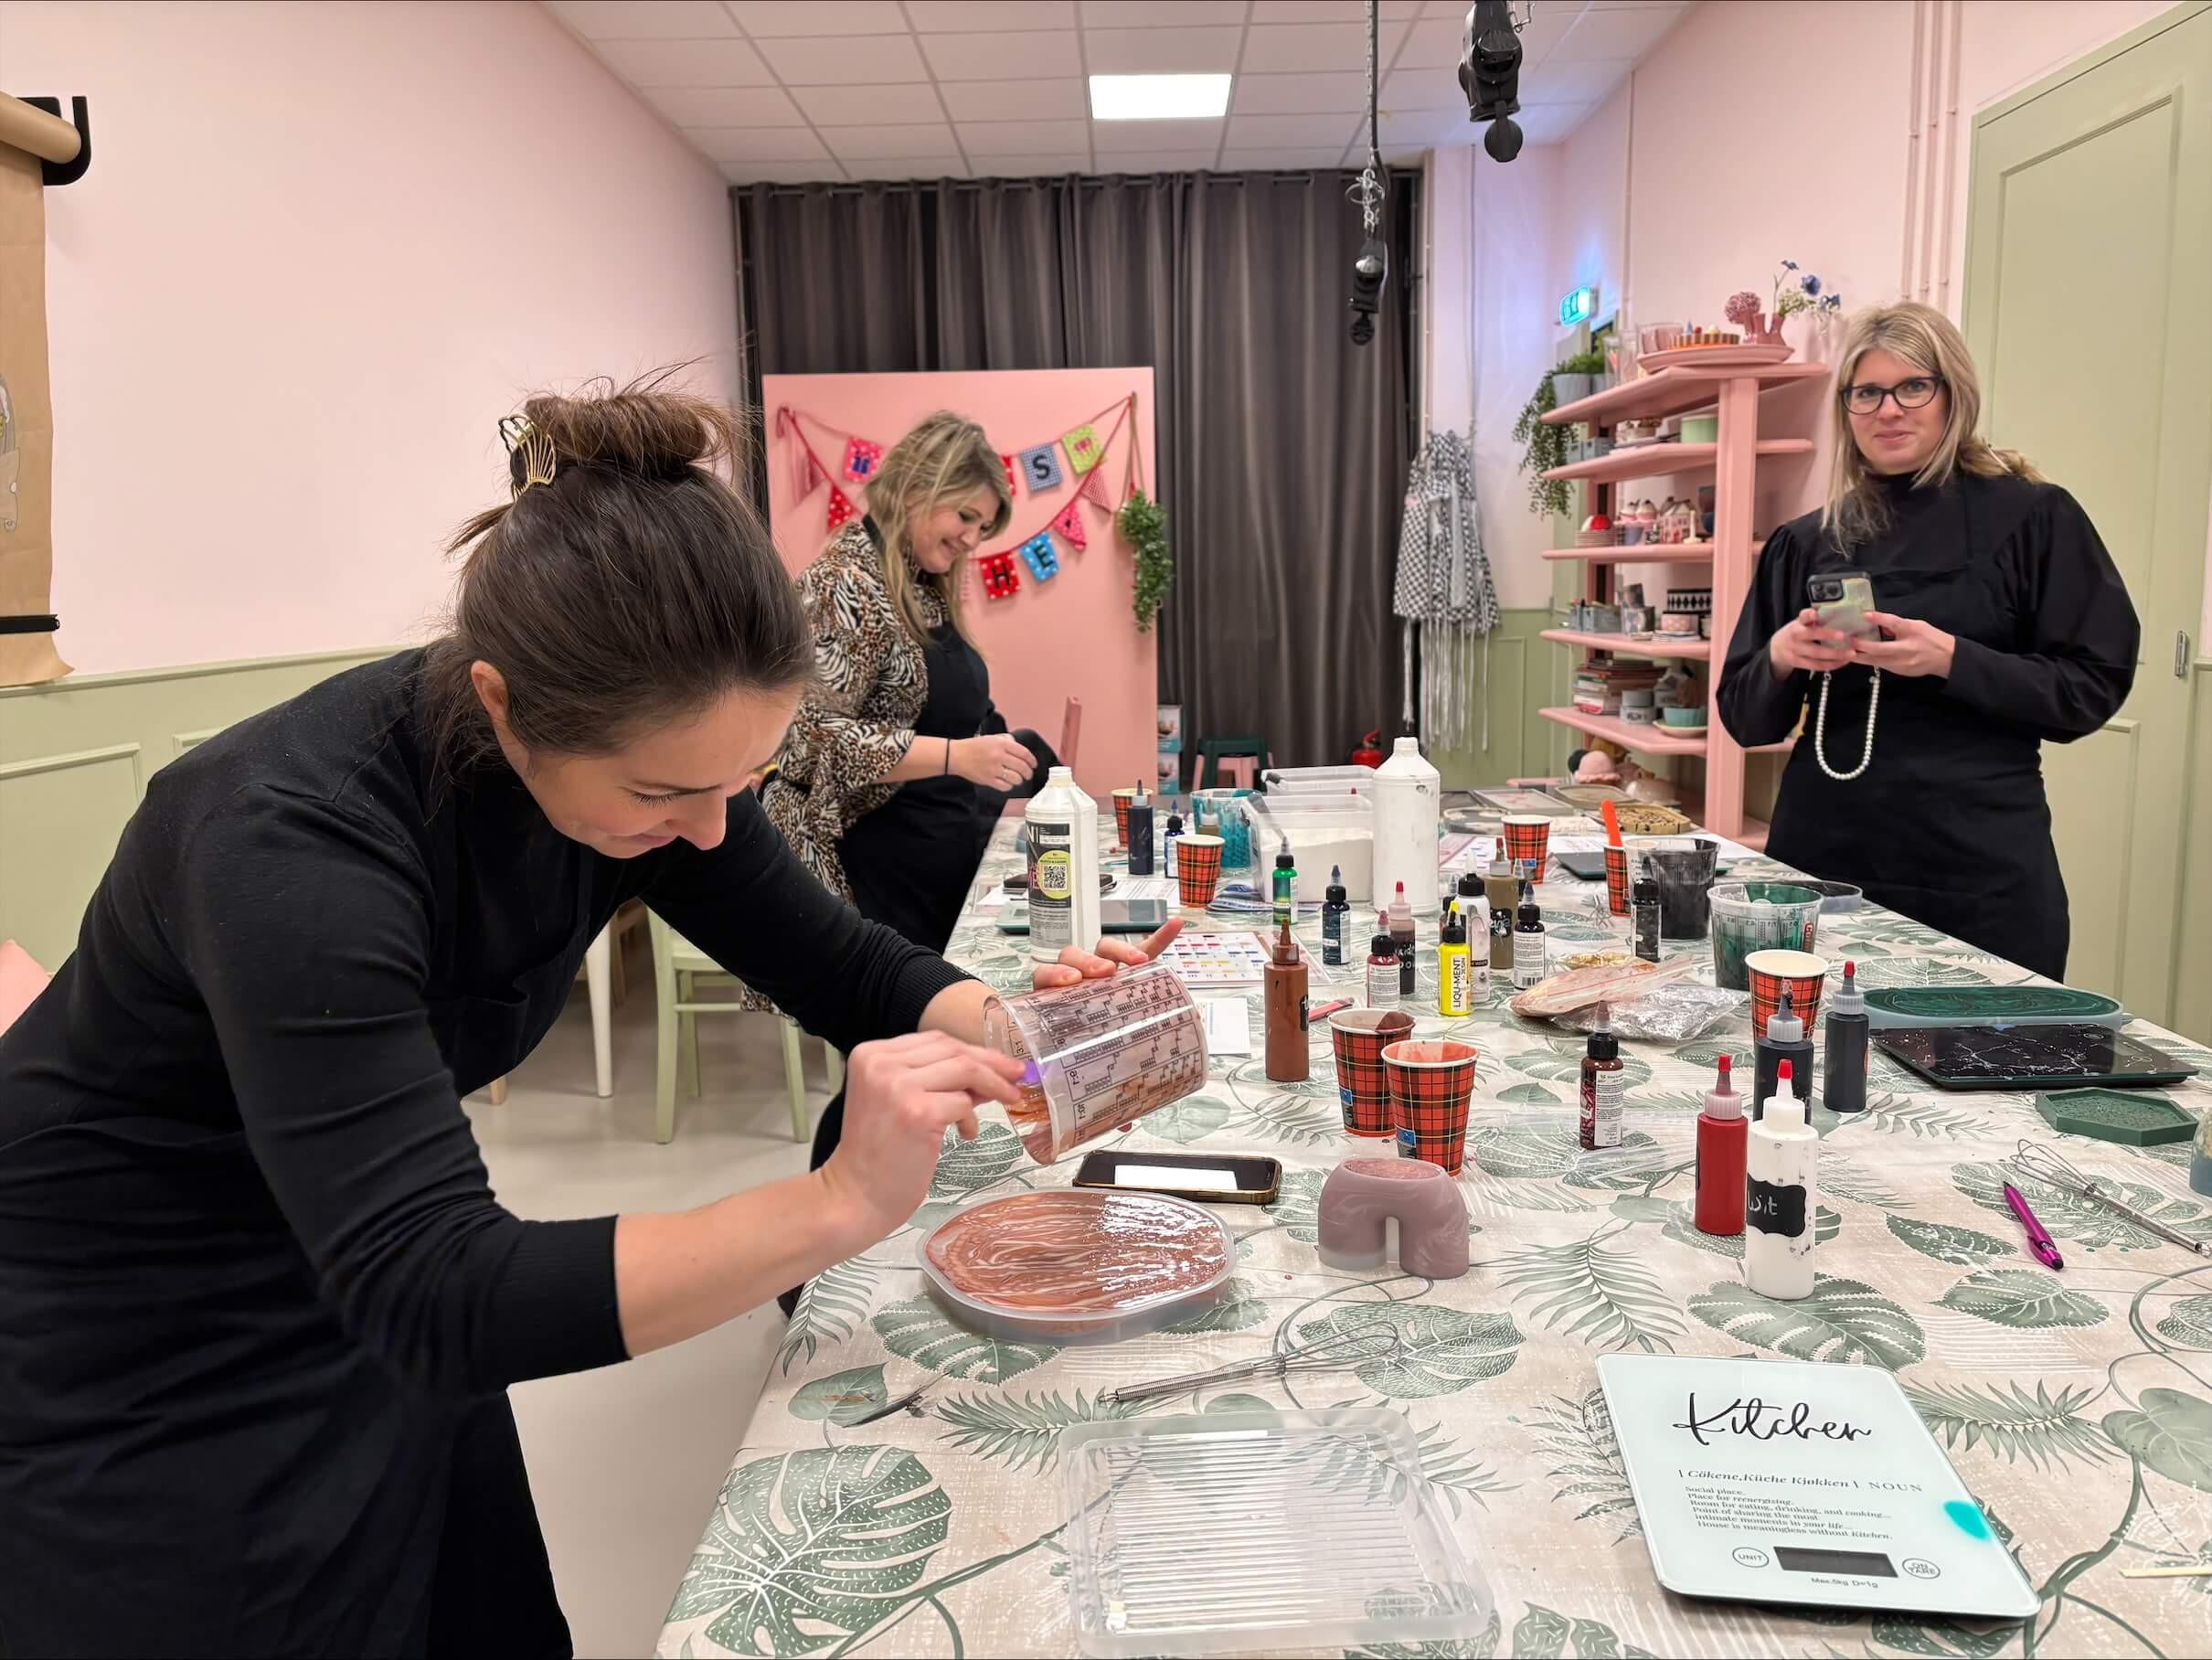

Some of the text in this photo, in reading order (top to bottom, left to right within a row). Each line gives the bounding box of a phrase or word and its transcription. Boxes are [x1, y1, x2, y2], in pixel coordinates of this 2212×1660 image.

[1031, 454, 1050, 480] S
[1452, 958, 1462, 1007] LIQU-MENT
[1747, 1190, 1778, 1216] Wit
[1672, 1392, 1872, 1446] Kitchen
[1685, 1485, 1715, 1494] Social
[1868, 1481, 1922, 1492] NOUN
[1733, 1510, 1771, 1518] sharing
[1740, 1516, 1788, 1525] moments
[1697, 1520, 1730, 1528] House
[1743, 1524, 1807, 1534] meaningless
[1809, 1528, 1848, 1537] without
[1738, 1552, 1763, 1561] UNIT
[1911, 1561, 1929, 1570] ON
[1908, 1566, 1936, 1576] TARE
